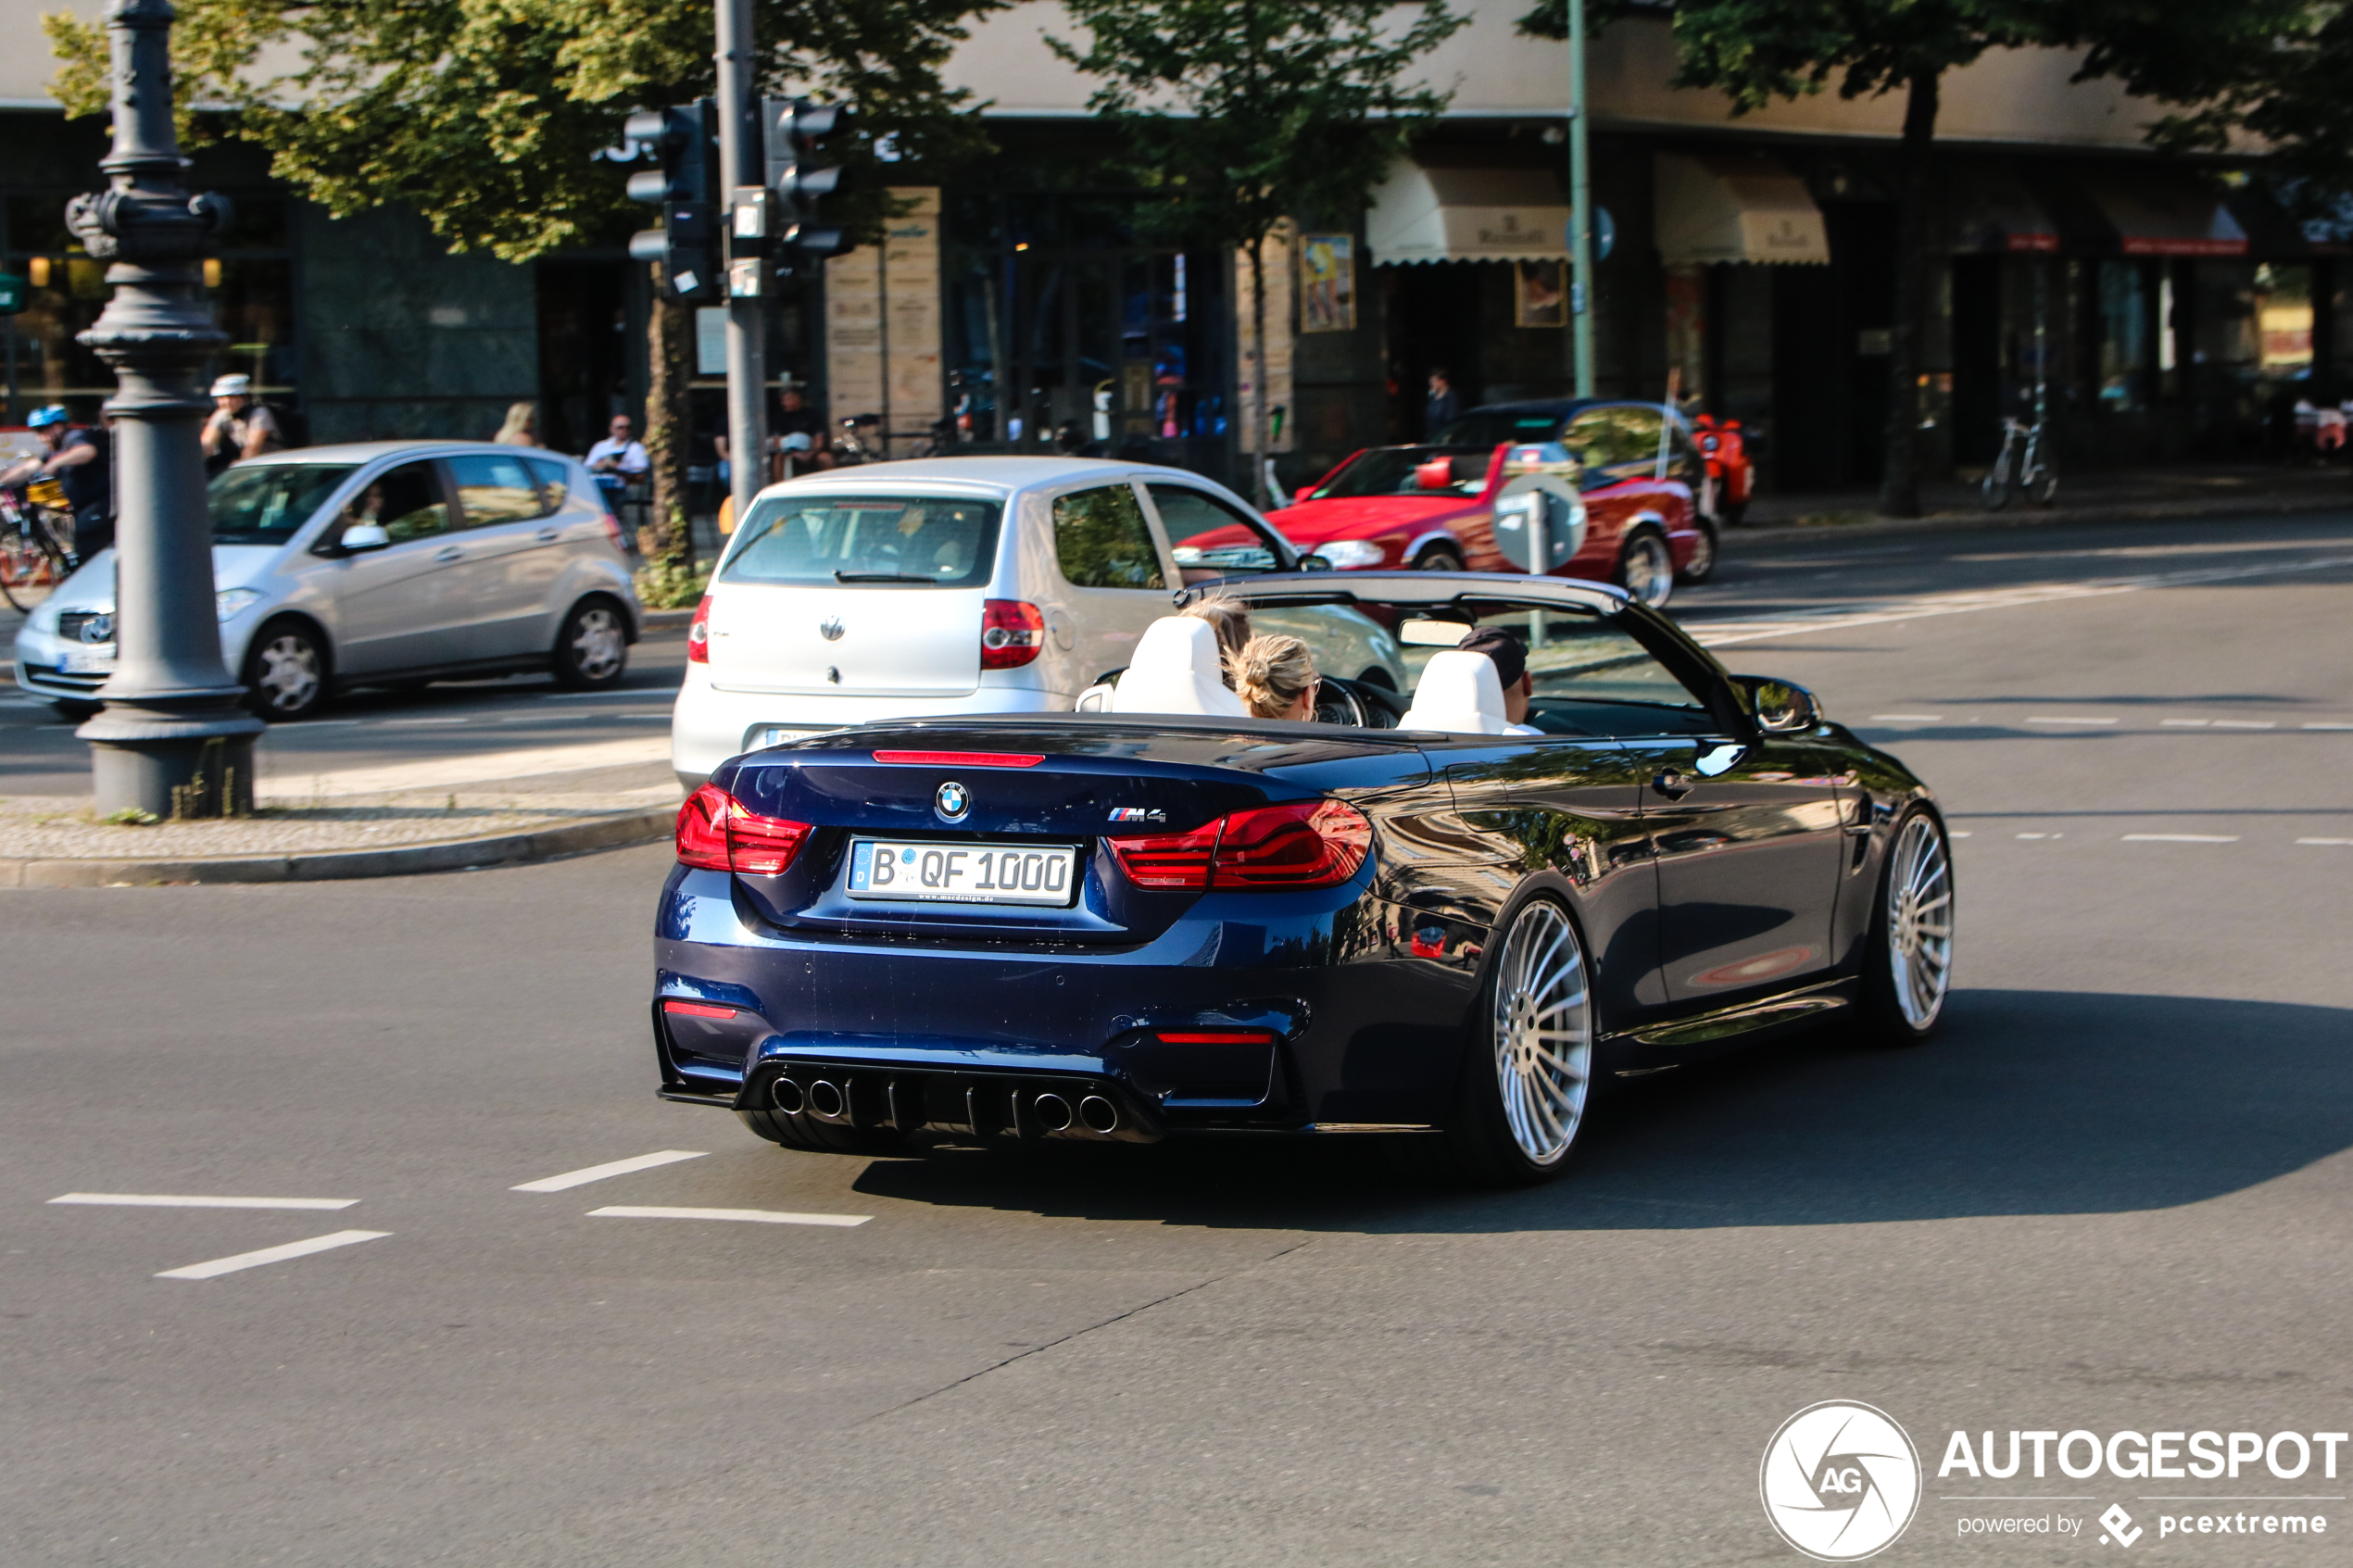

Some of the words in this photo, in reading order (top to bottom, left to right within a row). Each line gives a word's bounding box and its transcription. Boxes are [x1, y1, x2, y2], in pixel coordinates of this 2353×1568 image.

[939, 784, 965, 795] BMW
[1121, 808, 1165, 822] M4
[873, 848, 896, 885] B
[921, 850, 968, 888] QF
[975, 852, 1066, 892] 1000
[856, 871, 864, 883] D
[918, 894, 994, 902] www.mecdesign.de
